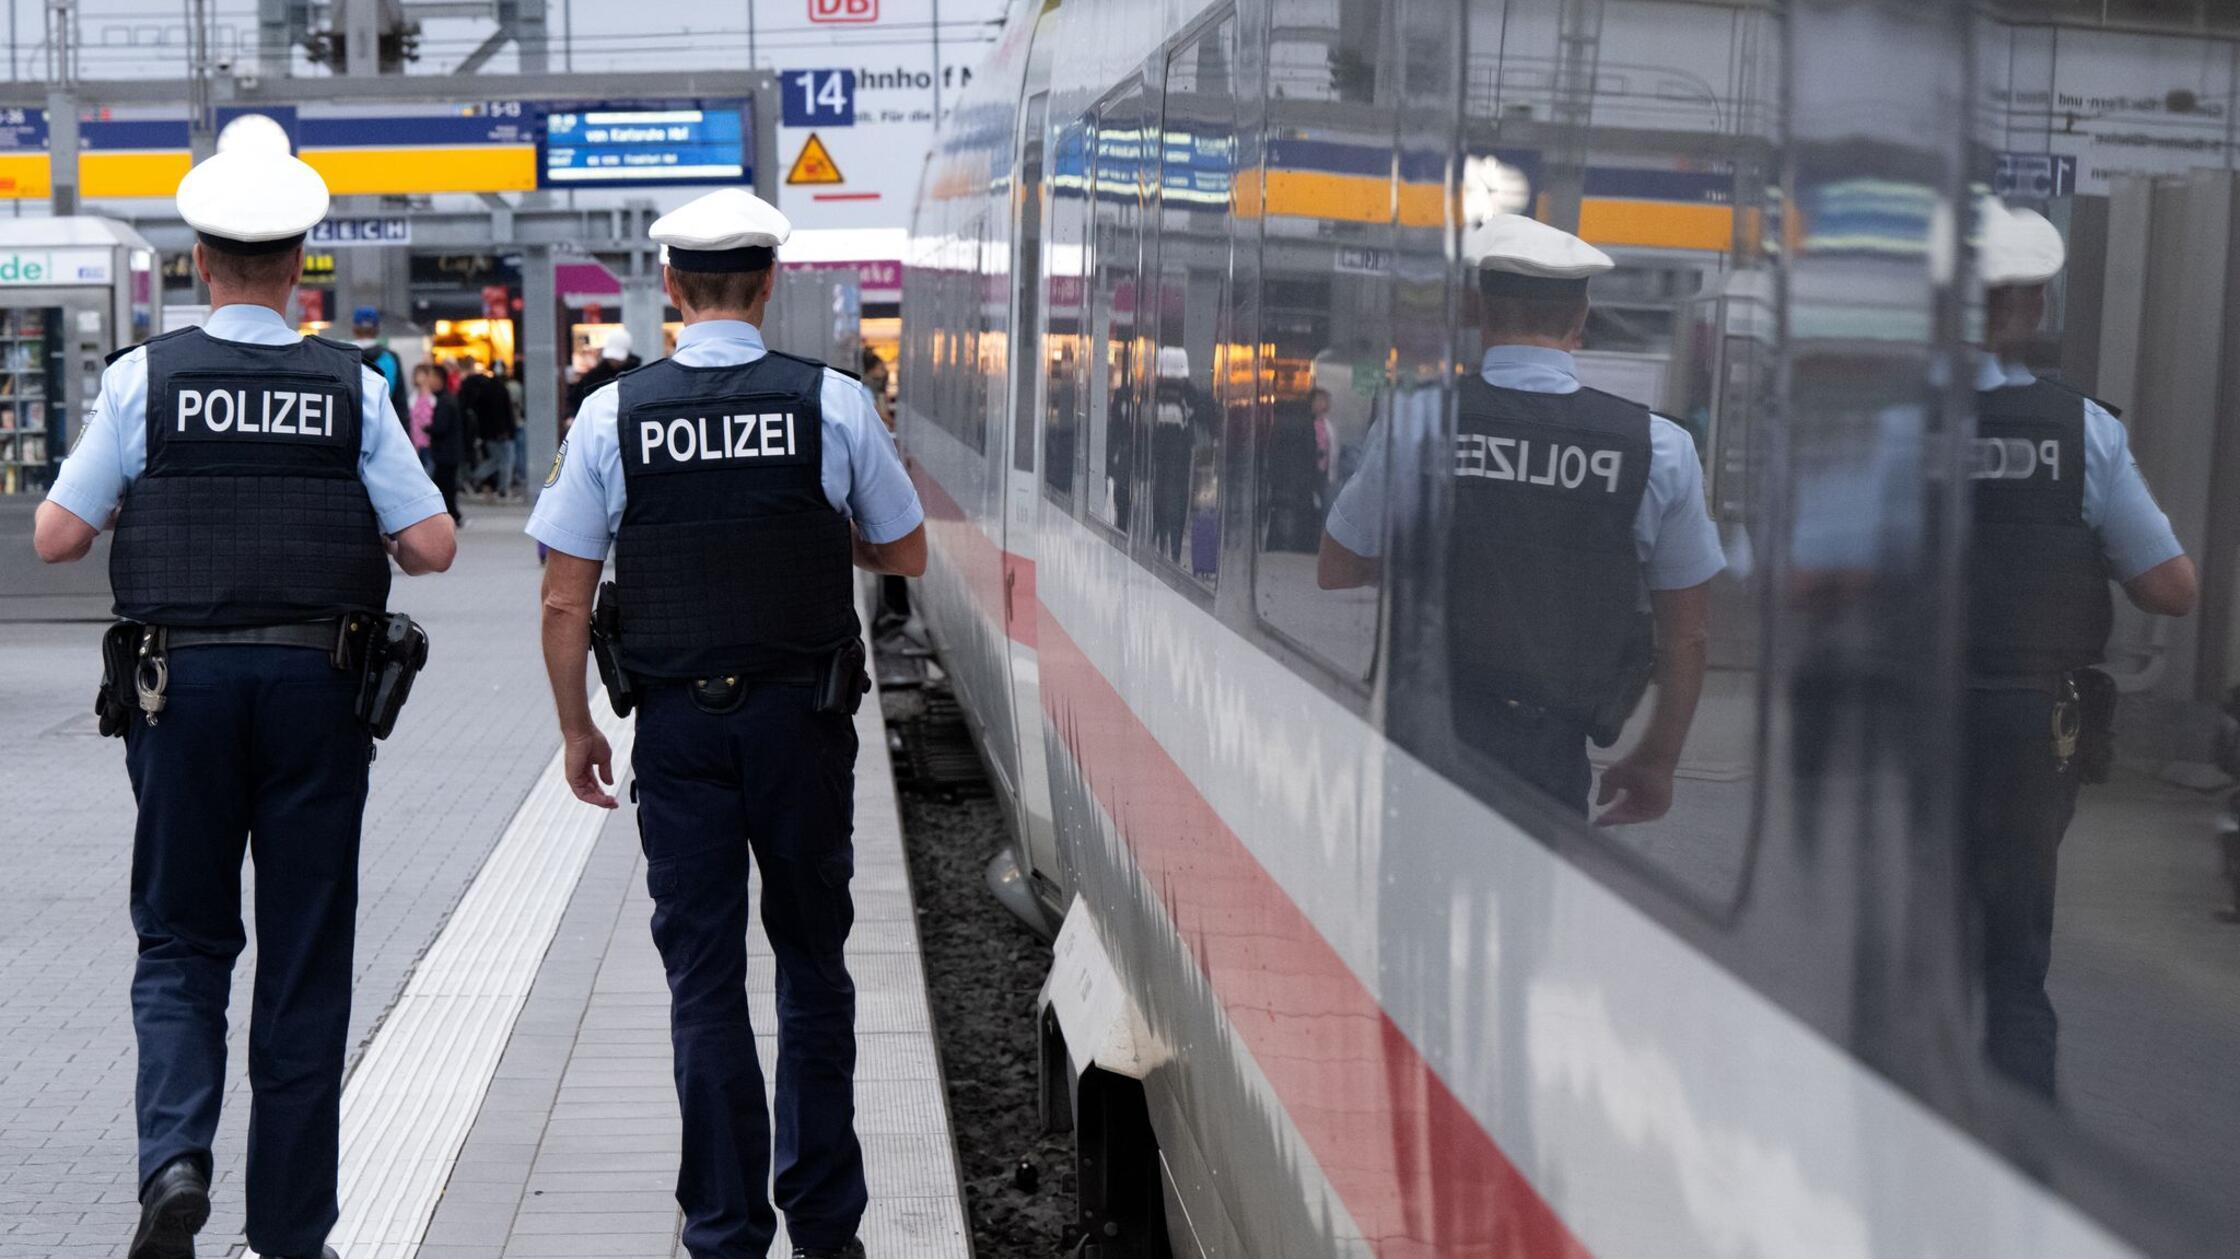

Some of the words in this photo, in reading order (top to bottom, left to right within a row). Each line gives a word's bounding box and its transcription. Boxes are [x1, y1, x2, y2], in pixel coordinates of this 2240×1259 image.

[795, 71, 848, 115] 14
[855, 67, 953, 88] hnhof
[316, 220, 404, 240] ZECH
[177, 389, 333, 436] POLIZEI
[640, 413, 796, 464] POLIZEI
